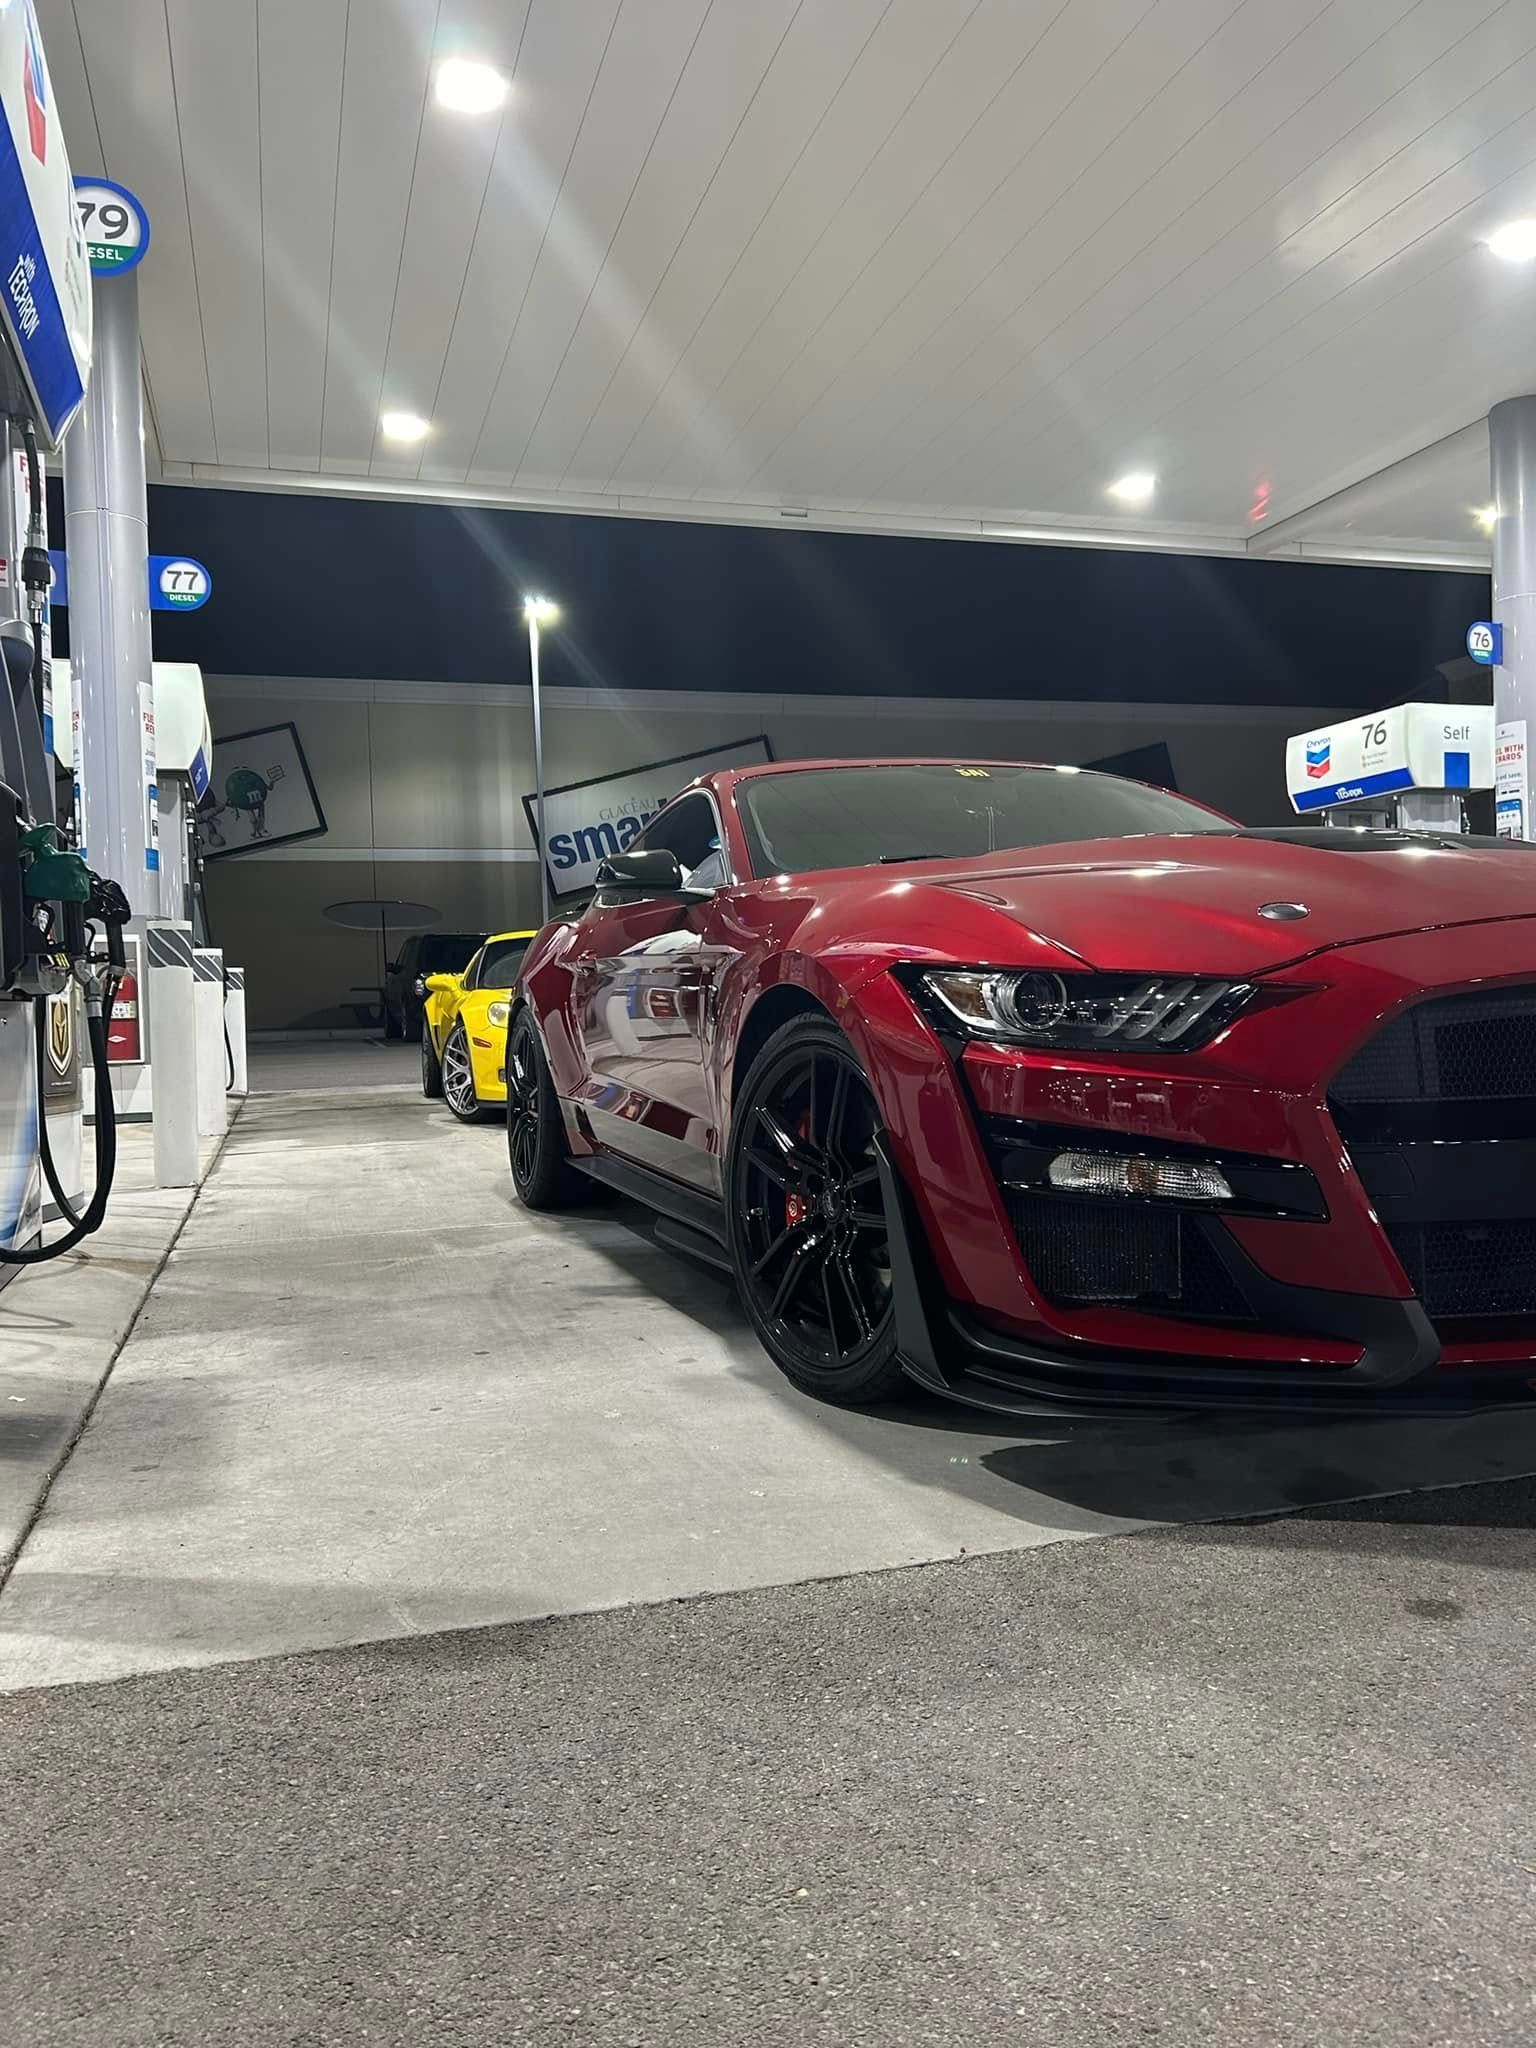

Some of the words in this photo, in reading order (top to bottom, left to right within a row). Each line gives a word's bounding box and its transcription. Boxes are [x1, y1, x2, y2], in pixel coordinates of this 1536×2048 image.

[77, 202, 129, 239] 79
[88, 247, 124, 261] ESEL
[8, 254, 40, 340] TECHRON
[166, 570, 199, 590] 77
[169, 594, 198, 602] DIESEL
[1473, 632, 1490, 648] 76
[1362, 720, 1387, 749] 76
[1443, 726, 1470, 740] Self
